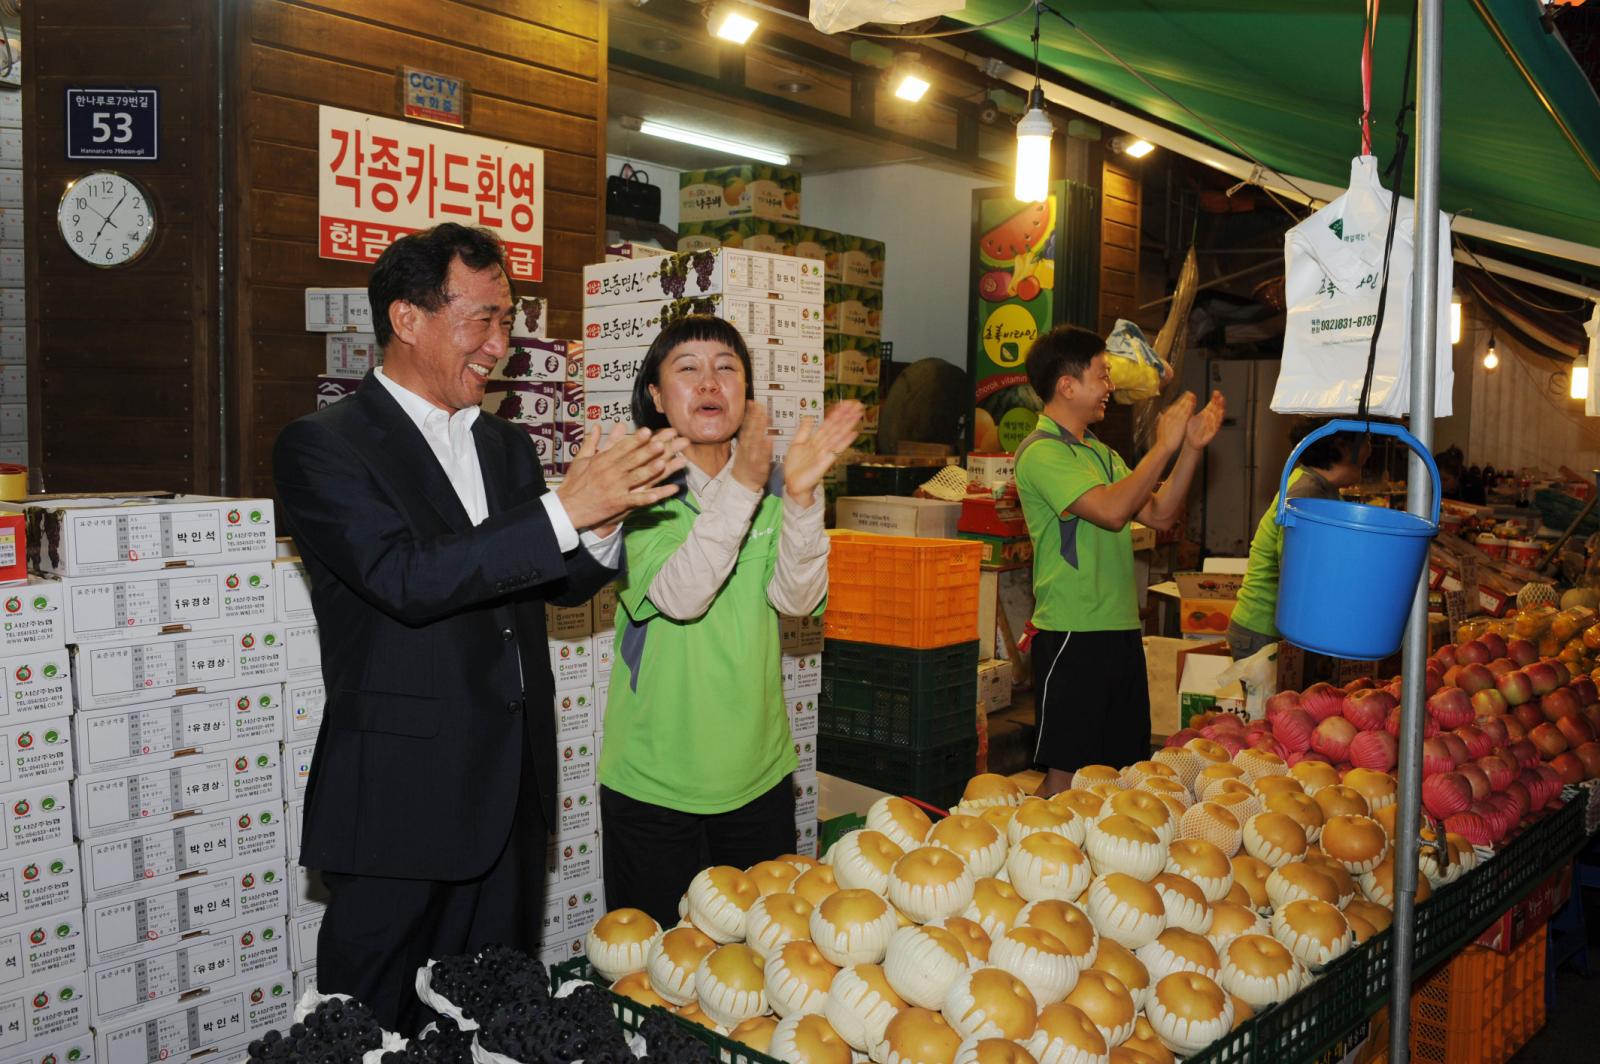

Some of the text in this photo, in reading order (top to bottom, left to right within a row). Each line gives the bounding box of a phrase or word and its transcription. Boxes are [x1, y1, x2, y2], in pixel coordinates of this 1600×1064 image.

[409, 72, 457, 95] CCTV
[75, 95, 149, 108] 한나루로79번길
[92, 112, 133, 143] 53
[80, 147, 113, 155] Hannaru-ro
[102, 181, 113, 193] 12
[329, 128, 535, 233] 각종카드환영
[88, 185, 98, 197] 11
[75, 197, 87, 209] 10
[132, 197, 141, 209] 2
[72, 214, 80, 226] 9
[136, 215, 144, 227] 3
[75, 230, 84, 243] 8
[89, 243, 97, 256] 7
[105, 248, 113, 260] 6
[122, 243, 130, 256] 5
[1000, 375, 1028, 385] vitamin
[177, 530, 216, 544] 박인석
[190, 837, 227, 855] 박인석
[193, 897, 231, 915] 박인석
[203, 1013, 240, 1032] 박인석
